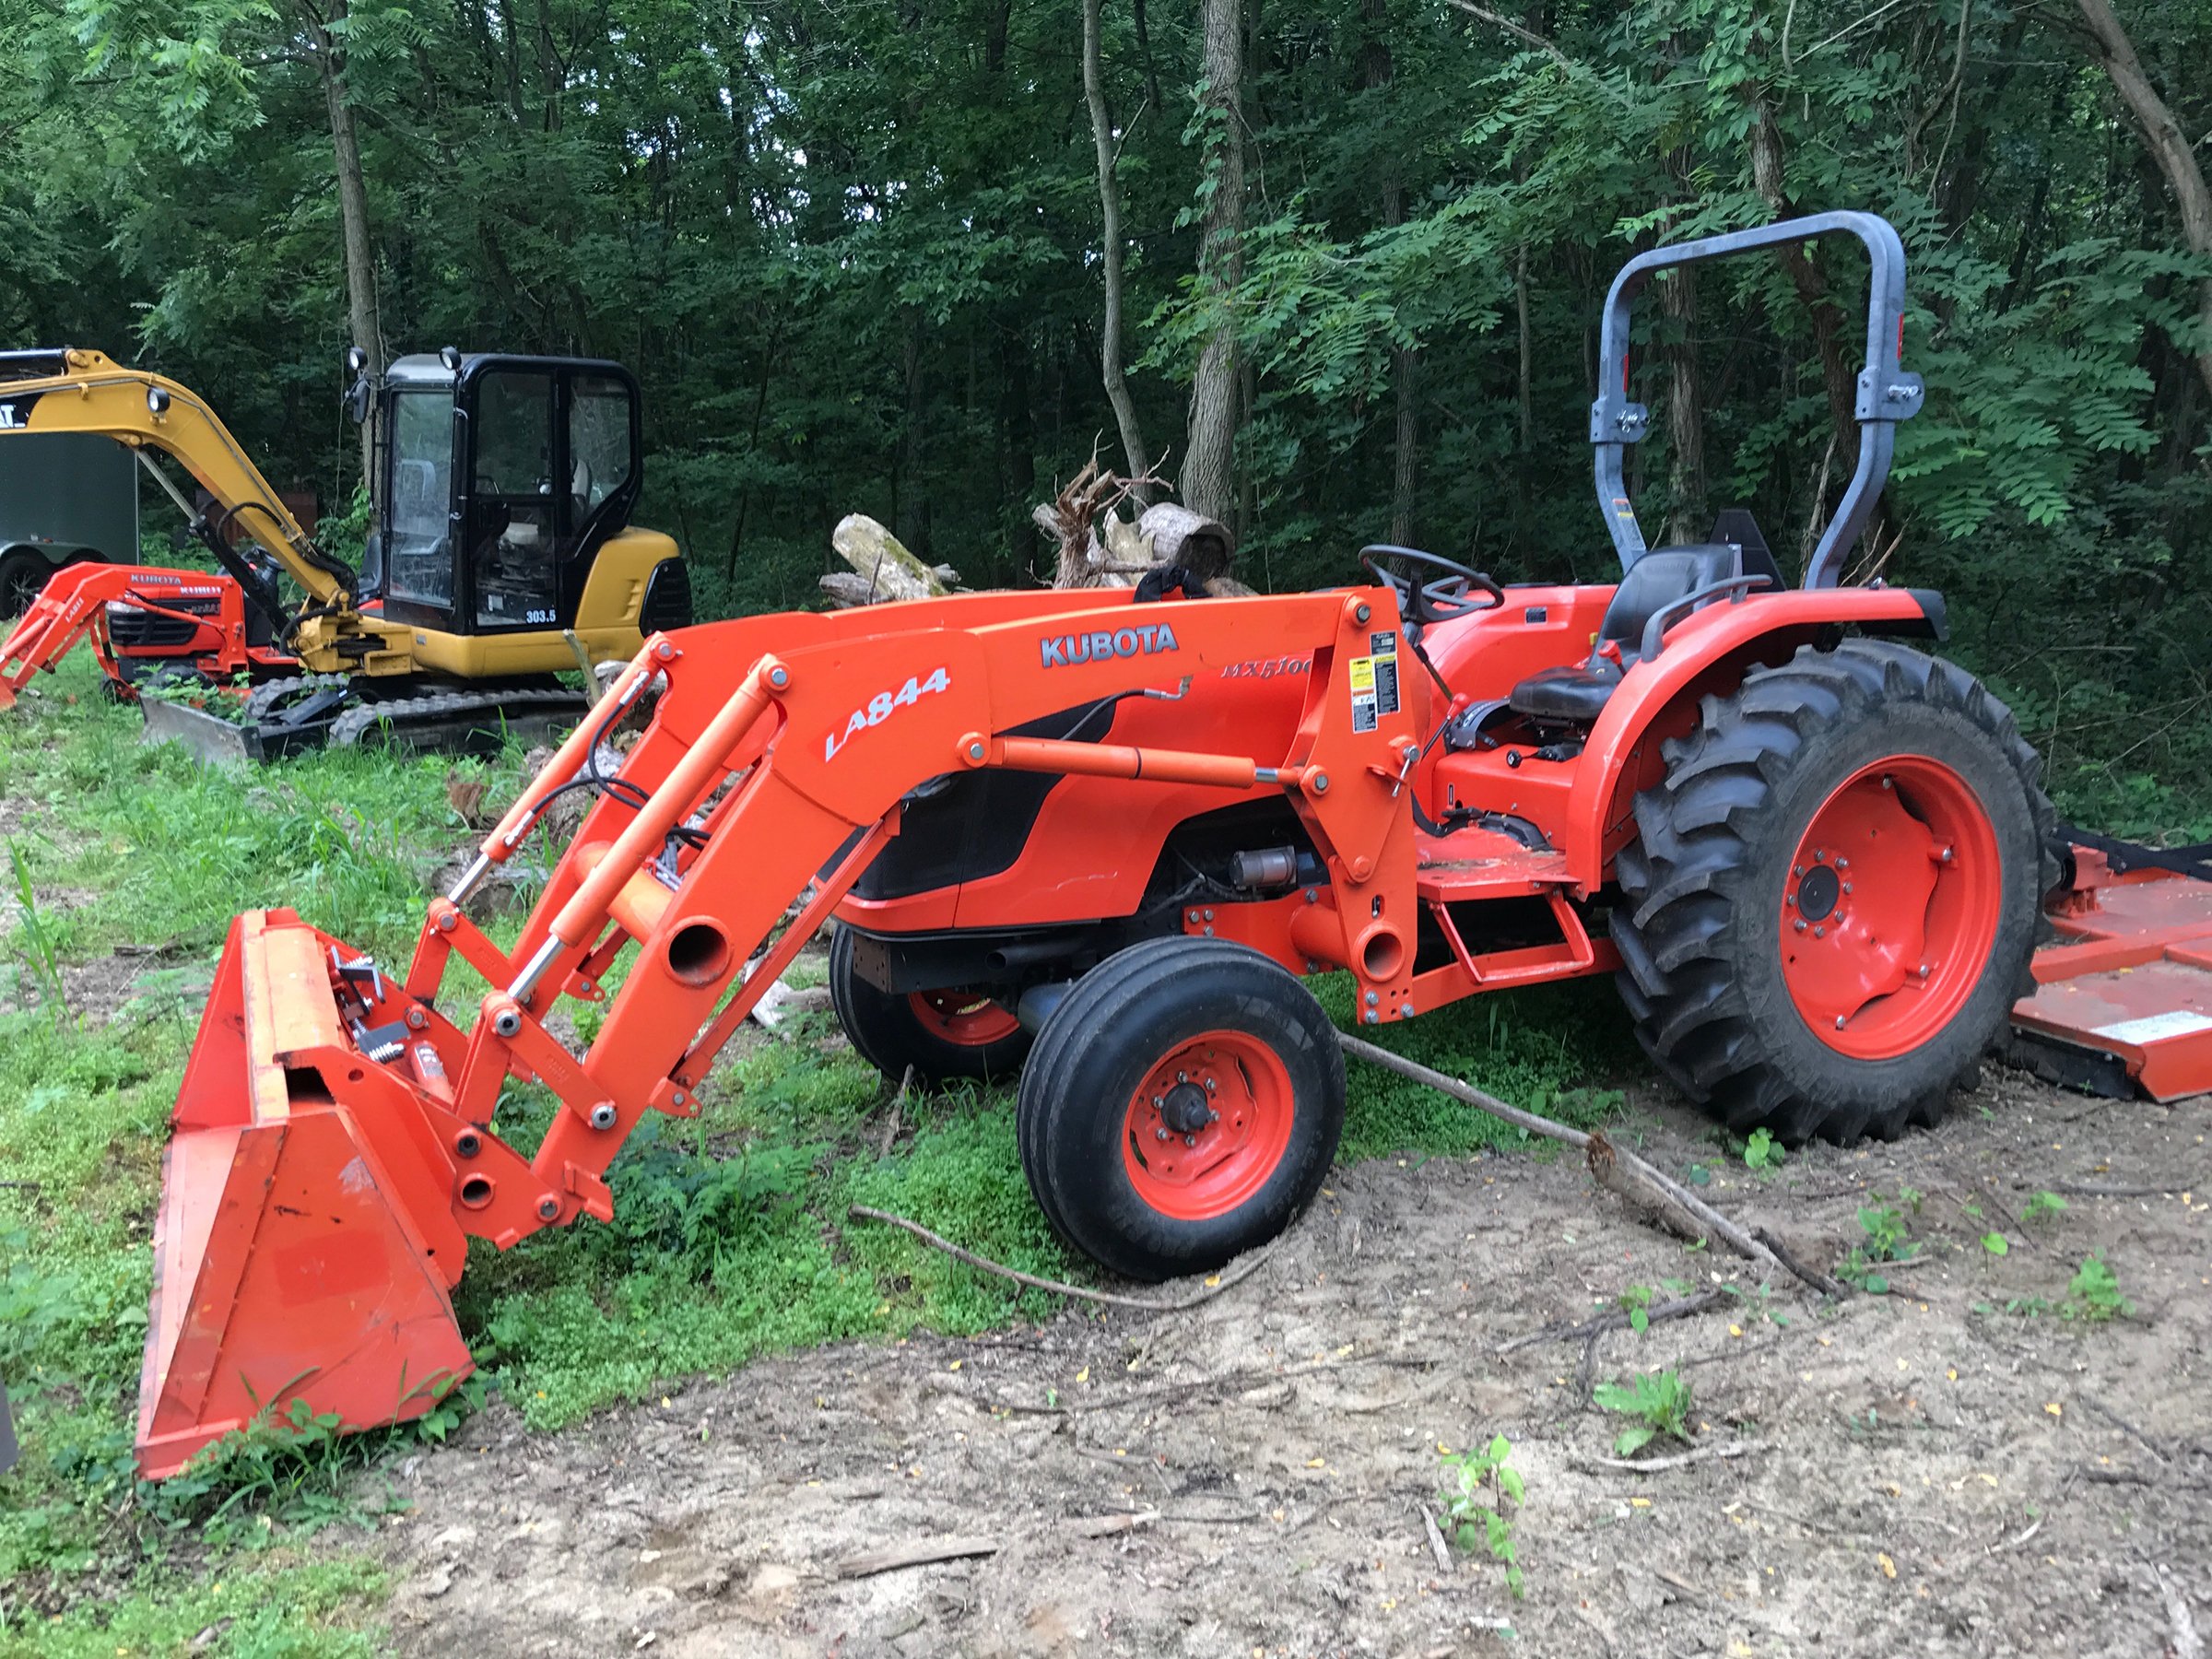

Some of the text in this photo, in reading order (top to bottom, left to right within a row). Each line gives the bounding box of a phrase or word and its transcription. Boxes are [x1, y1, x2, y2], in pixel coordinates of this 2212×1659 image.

[131, 573, 182, 585] KUBOTA
[180, 586, 221, 595] KUBOT
[526, 609, 557, 624] 303.5
[1040, 622, 1179, 669] KUBOTA
[826, 667, 950, 763] LA844
